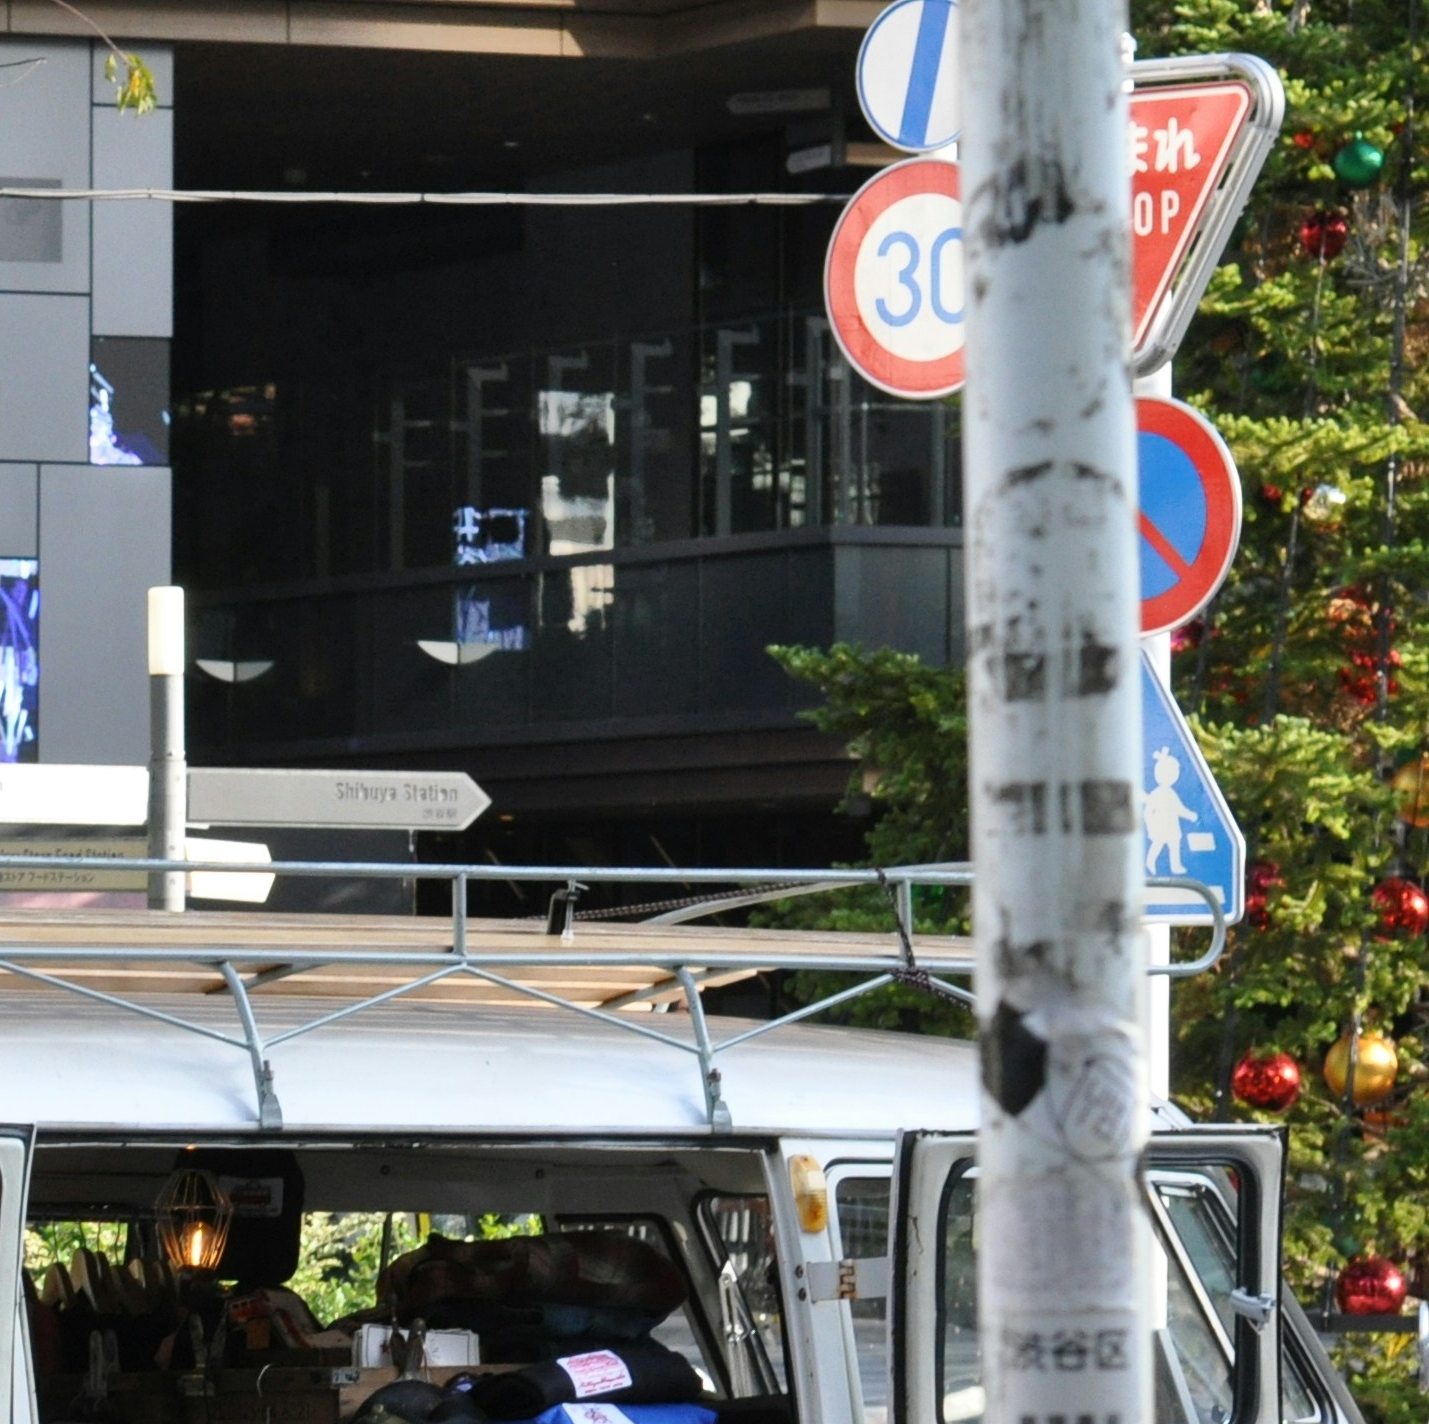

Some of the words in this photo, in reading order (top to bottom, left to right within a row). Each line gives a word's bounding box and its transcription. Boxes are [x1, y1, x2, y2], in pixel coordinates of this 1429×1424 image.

[1128, 116, 1201, 177] まれ
[1133, 189, 1180, 237] OP
[875, 227, 965, 327] 30
[335, 782, 397, 803] Shibuya
[403, 784, 458, 801] Station
